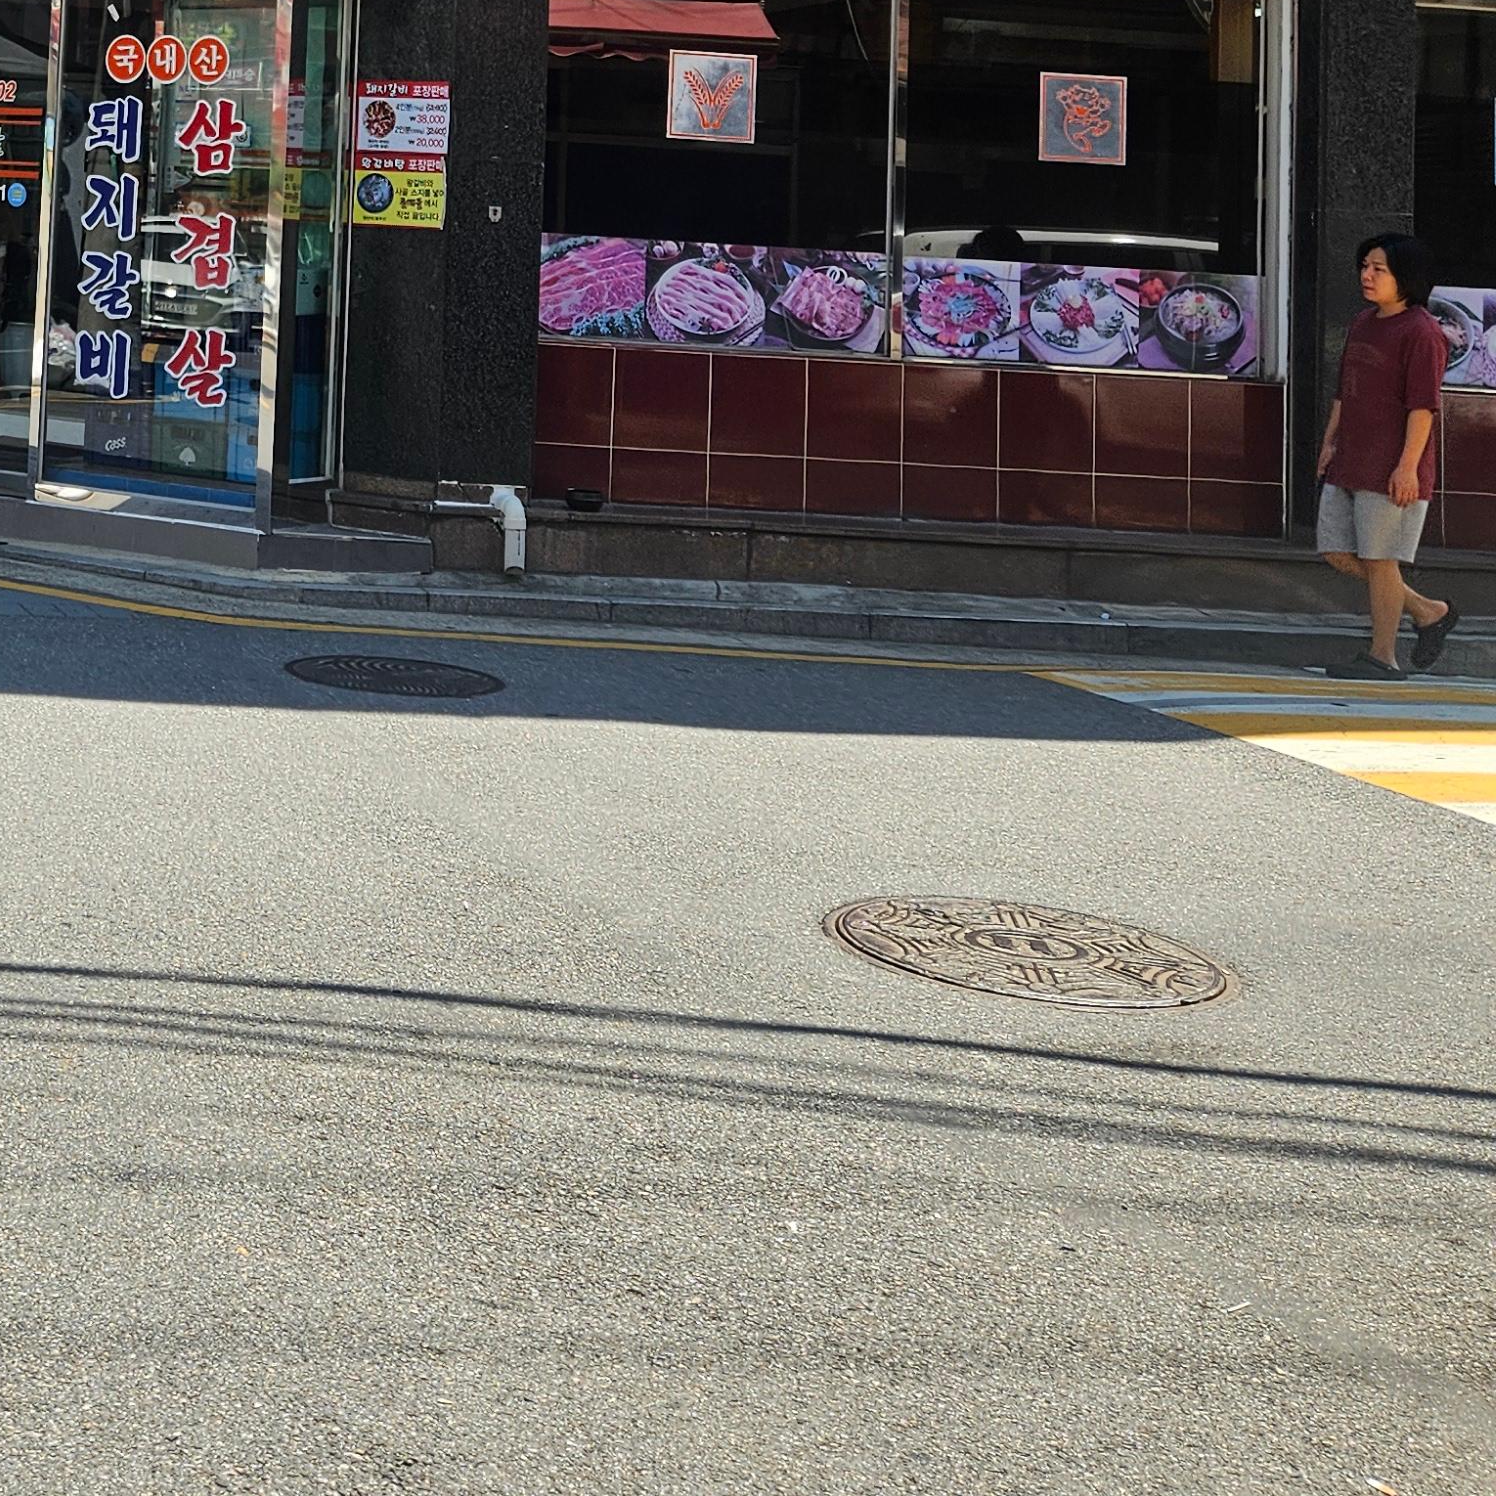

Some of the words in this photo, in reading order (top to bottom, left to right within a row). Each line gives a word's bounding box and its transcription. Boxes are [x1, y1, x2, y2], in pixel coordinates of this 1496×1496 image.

[111, 42, 224, 78] 국내산
[365, 83, 408, 97] 돼지갈비
[412, 85, 449, 98] 포장판매
[75, 95, 144, 399] 돼지갈비
[164, 98, 246, 408] 삼겹살
